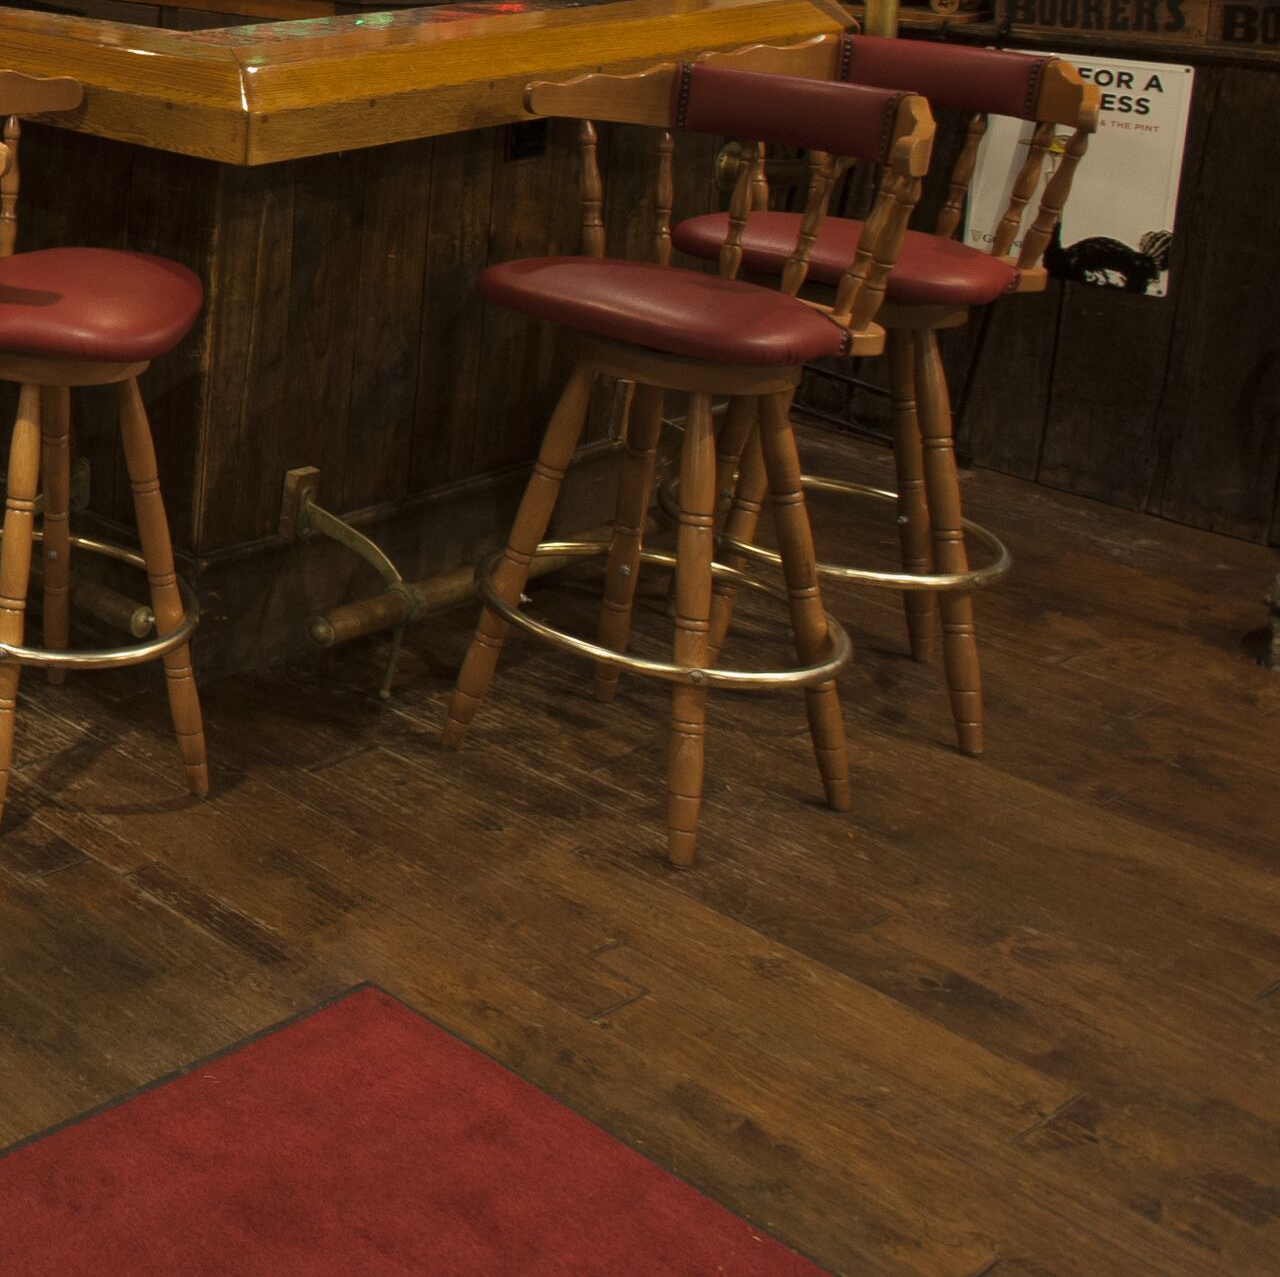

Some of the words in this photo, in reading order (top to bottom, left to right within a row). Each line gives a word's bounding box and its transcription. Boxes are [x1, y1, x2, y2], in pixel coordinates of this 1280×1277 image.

[1078, 68, 1134, 90] FOR
[1143, 74, 1163, 93] A
[1111, 120, 1131, 130] THE
[1135, 124, 1160, 133] PINT
